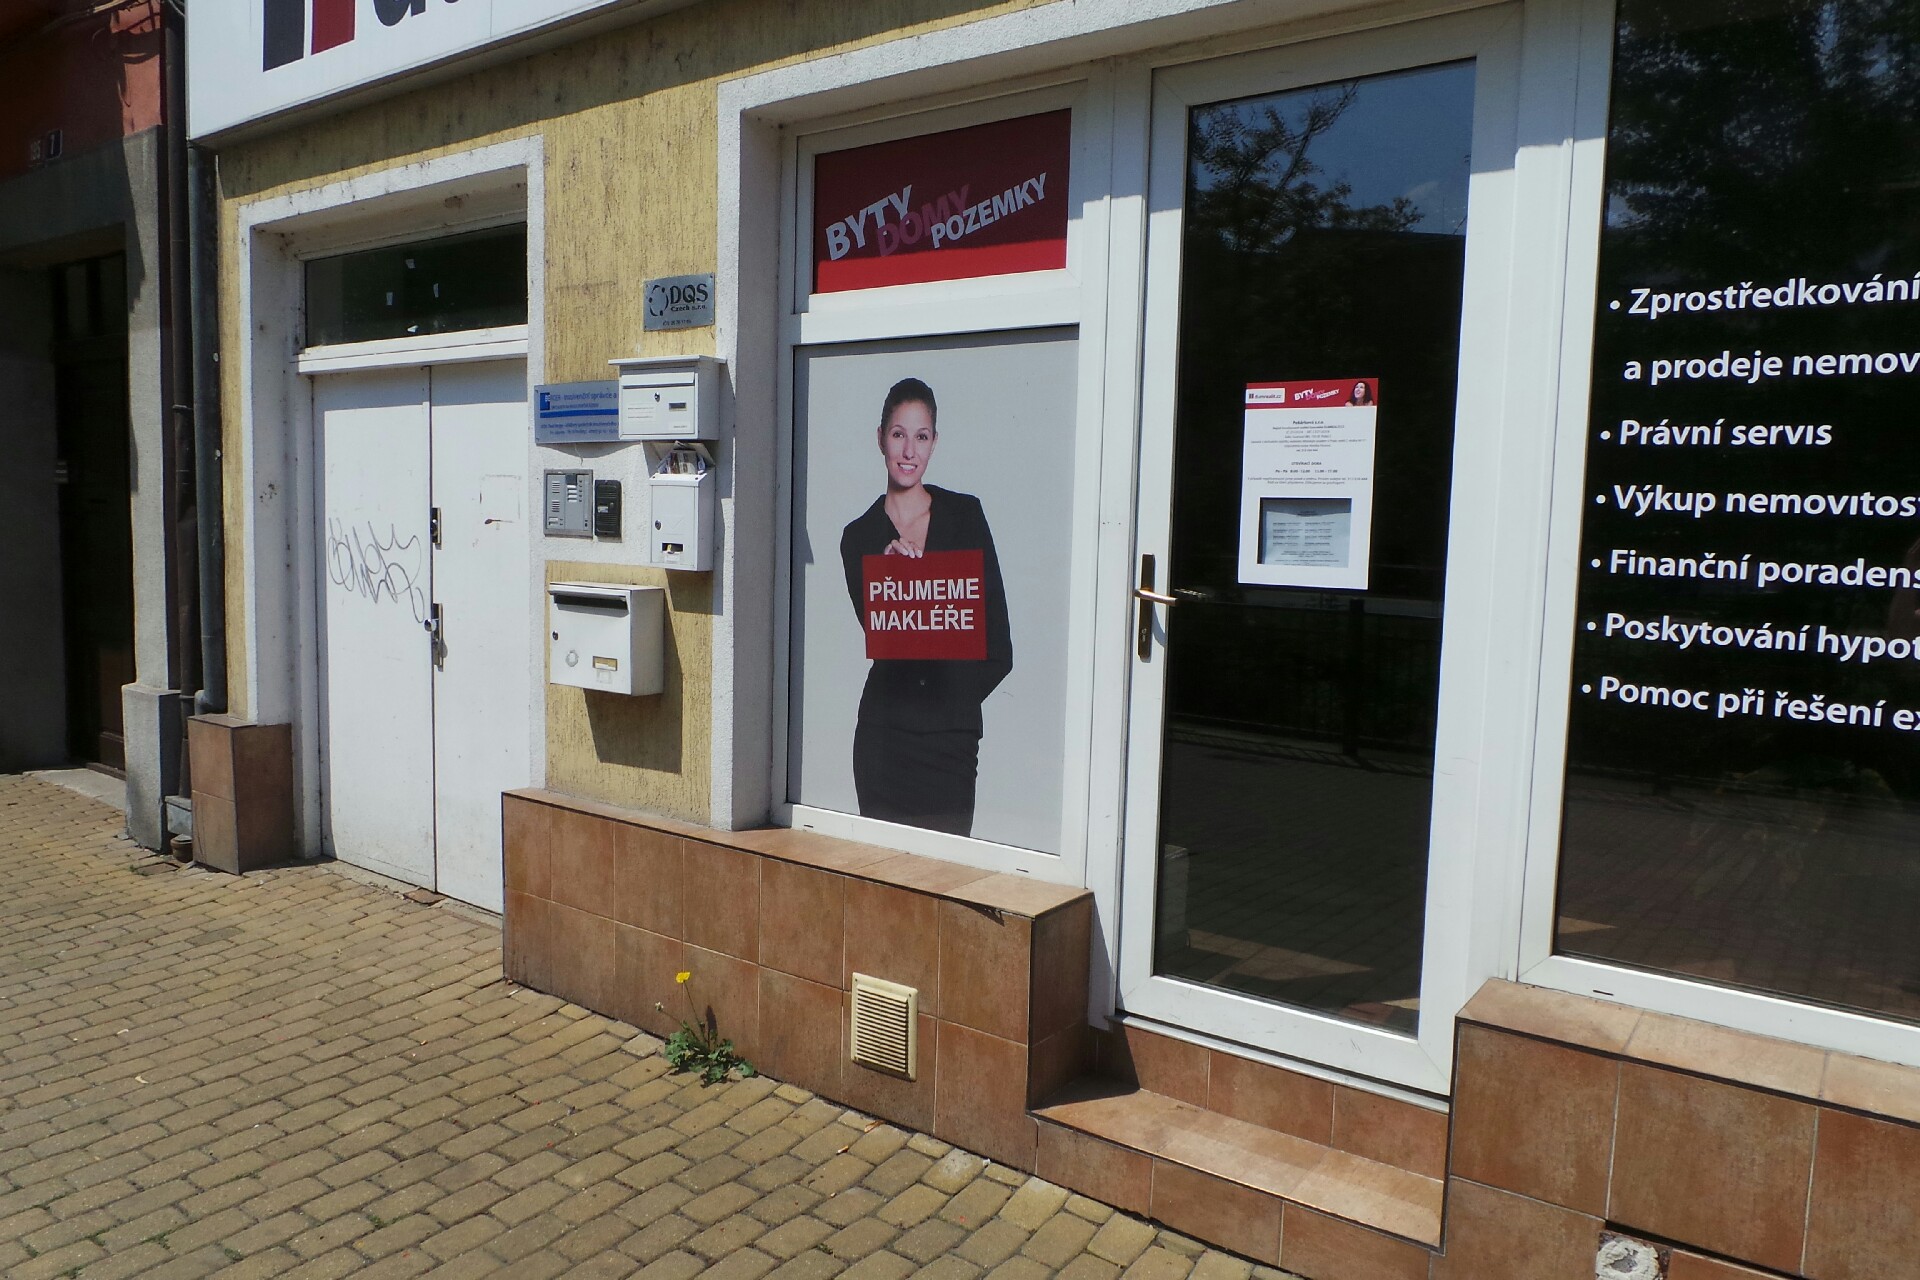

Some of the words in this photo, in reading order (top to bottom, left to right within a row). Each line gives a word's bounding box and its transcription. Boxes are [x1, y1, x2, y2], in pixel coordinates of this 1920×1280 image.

[825, 184, 912, 261] BYTY
[876, 184, 970, 257] DOMY
[930, 172, 1047, 249] POZEMKY
[670, 283, 708, 304] DQS
[671, 304, 690, 312] Czech
[1628, 271, 1920, 319] Zprostředkování
[1623, 360, 1642, 380] a
[1651, 350, 1783, 386] prodeje
[1619, 418, 1725, 445] Právní
[1731, 423, 1833, 446] servis
[1613, 483, 1716, 518] Výkup
[1725, 491, 1920, 517] nemovitos
[1610, 549, 1751, 580] Finanční
[869, 576, 980, 601] PŘIJMEME
[870, 604, 974, 630] MAKLÉŘE
[1605, 612, 1810, 651] Poskytování
[1600, 676, 1709, 710] Pomoc
[1717, 688, 1764, 718] při
[1774, 691, 1886, 727] řešení
